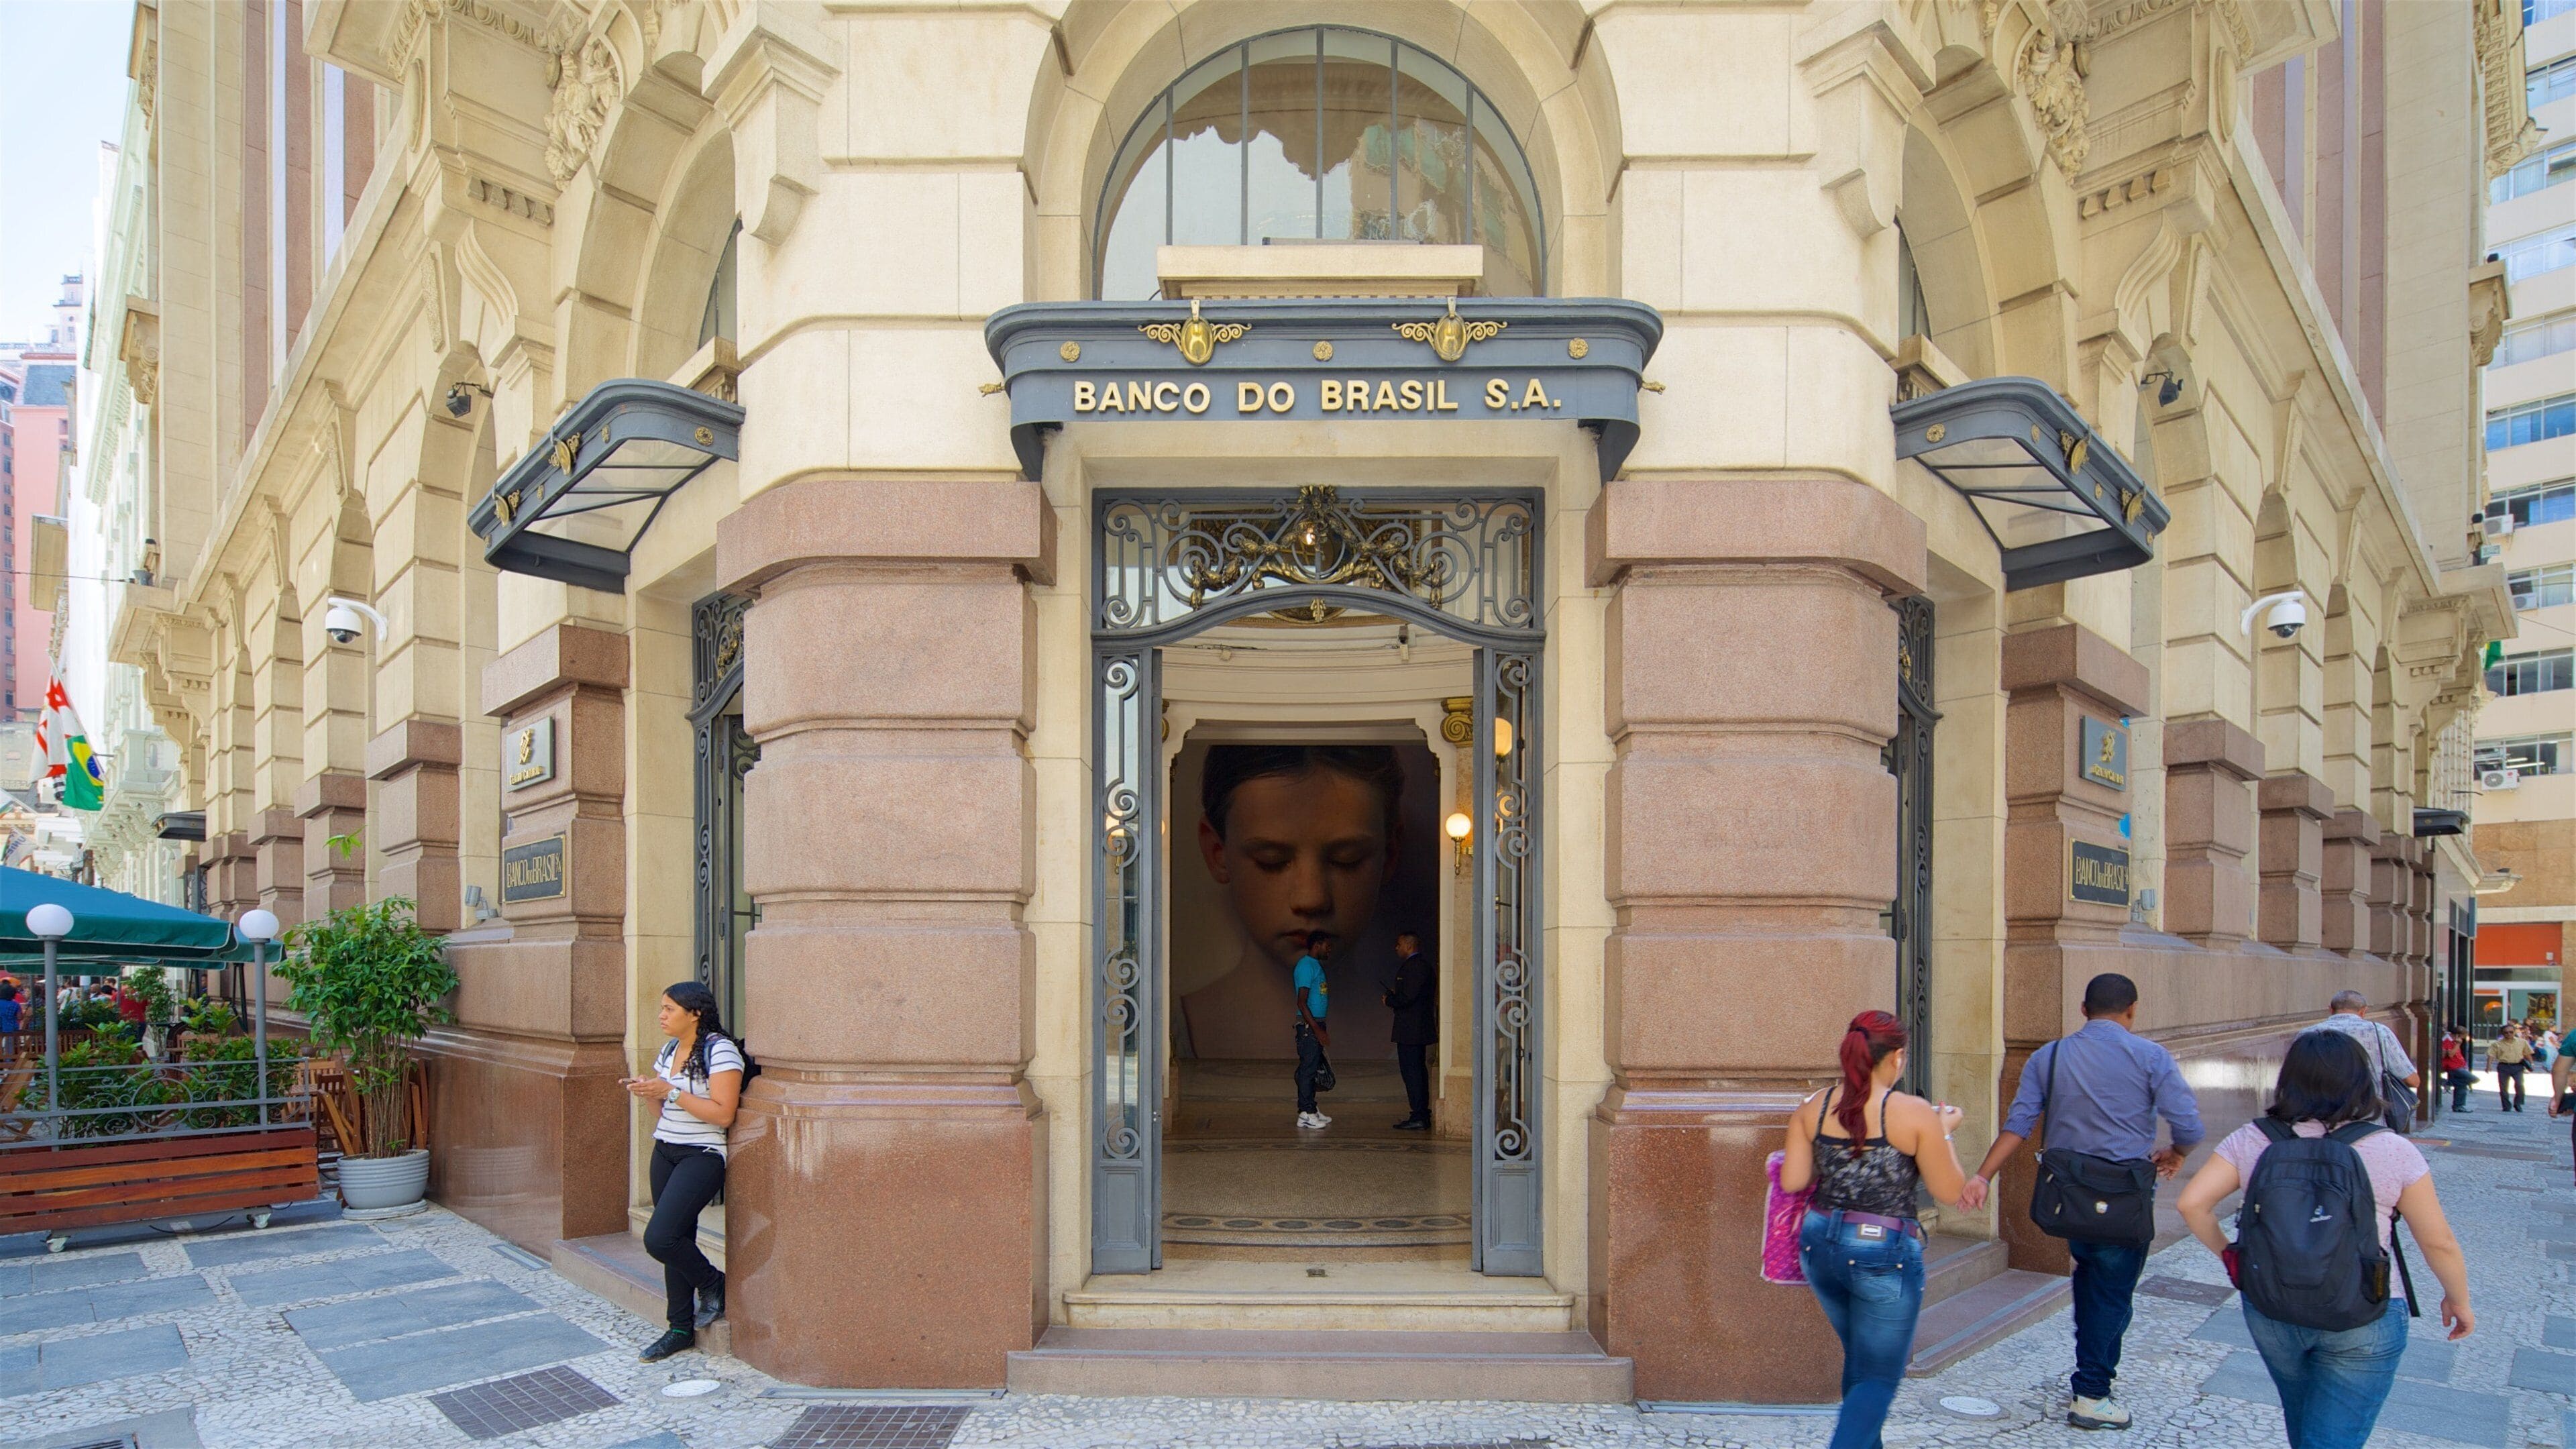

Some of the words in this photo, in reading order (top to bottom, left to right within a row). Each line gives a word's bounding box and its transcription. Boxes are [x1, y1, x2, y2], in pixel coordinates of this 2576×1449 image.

[1074, 380, 1211, 413] BANCO
[1238, 381, 1295, 413] DO
[1321, 380, 1458, 412] BRASIL
[1484, 378, 1562, 410] S.A.
[506, 859, 528, 888] BANCO
[533, 853, 558, 883] BRASIL
[2076, 856, 2100, 887] BANCO
[2104, 861, 2127, 892] BRASIL
